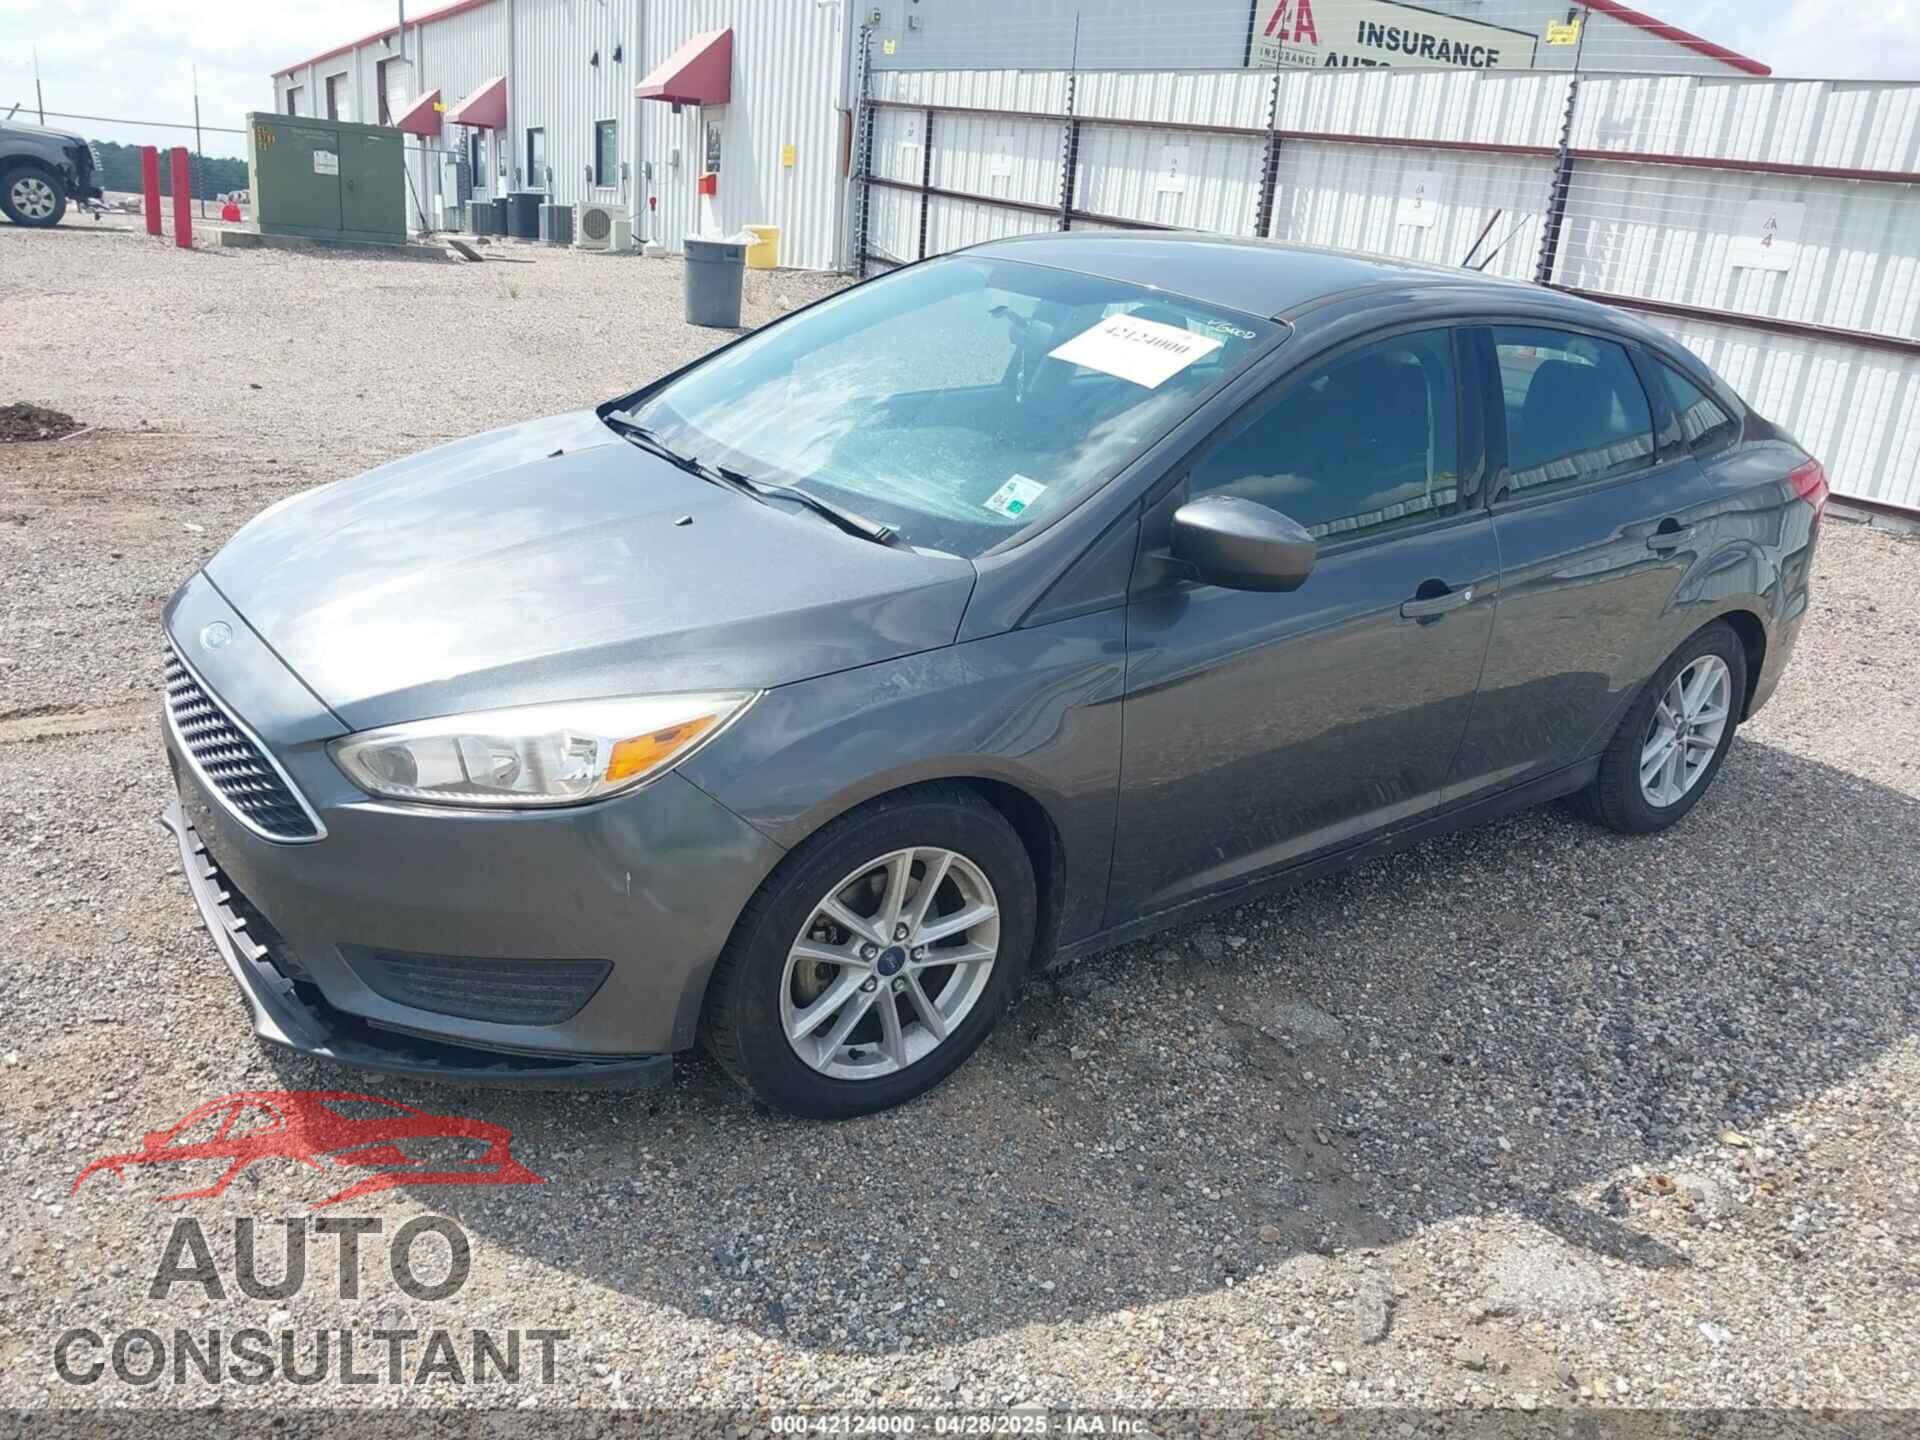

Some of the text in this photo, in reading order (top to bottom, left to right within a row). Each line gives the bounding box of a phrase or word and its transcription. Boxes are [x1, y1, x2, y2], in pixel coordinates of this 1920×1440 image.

[1259, 47, 1317, 67] INSURANCE
[1357, 20, 1500, 68] INSURANCE
[1105, 325, 1191, 354] 42124000
